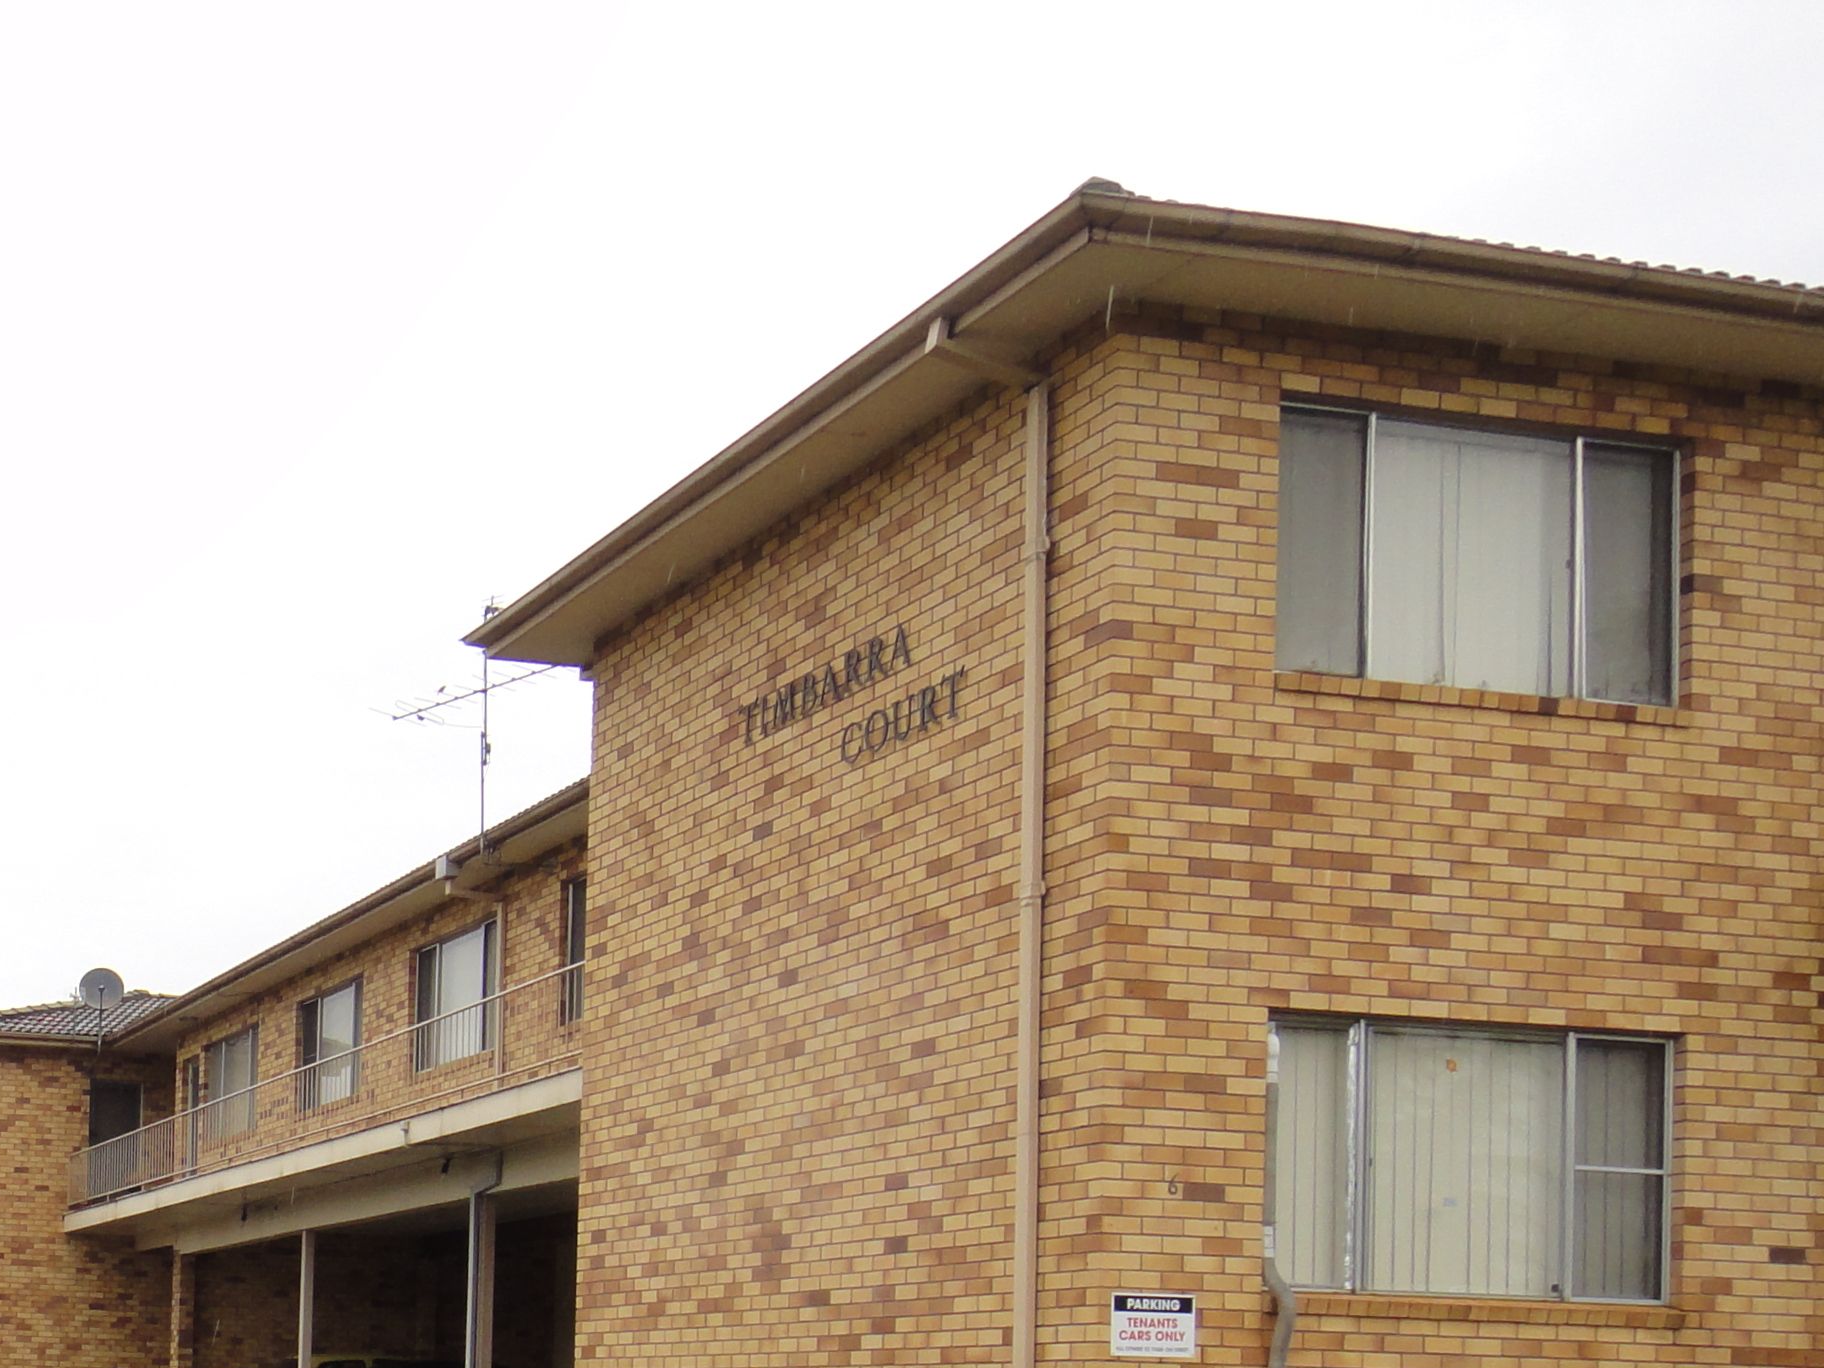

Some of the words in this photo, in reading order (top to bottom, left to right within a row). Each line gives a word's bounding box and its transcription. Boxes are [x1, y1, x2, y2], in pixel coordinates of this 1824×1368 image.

[738, 623, 911, 747] TIMBARRA
[840, 664, 967, 765] COURT
[1126, 1298, 1181, 1311] PARKING
[1127, 1317, 1179, 1329] TENANTS
[1119, 1330, 1152, 1341] CARS
[1154, 1331, 1186, 1342] ONLY
